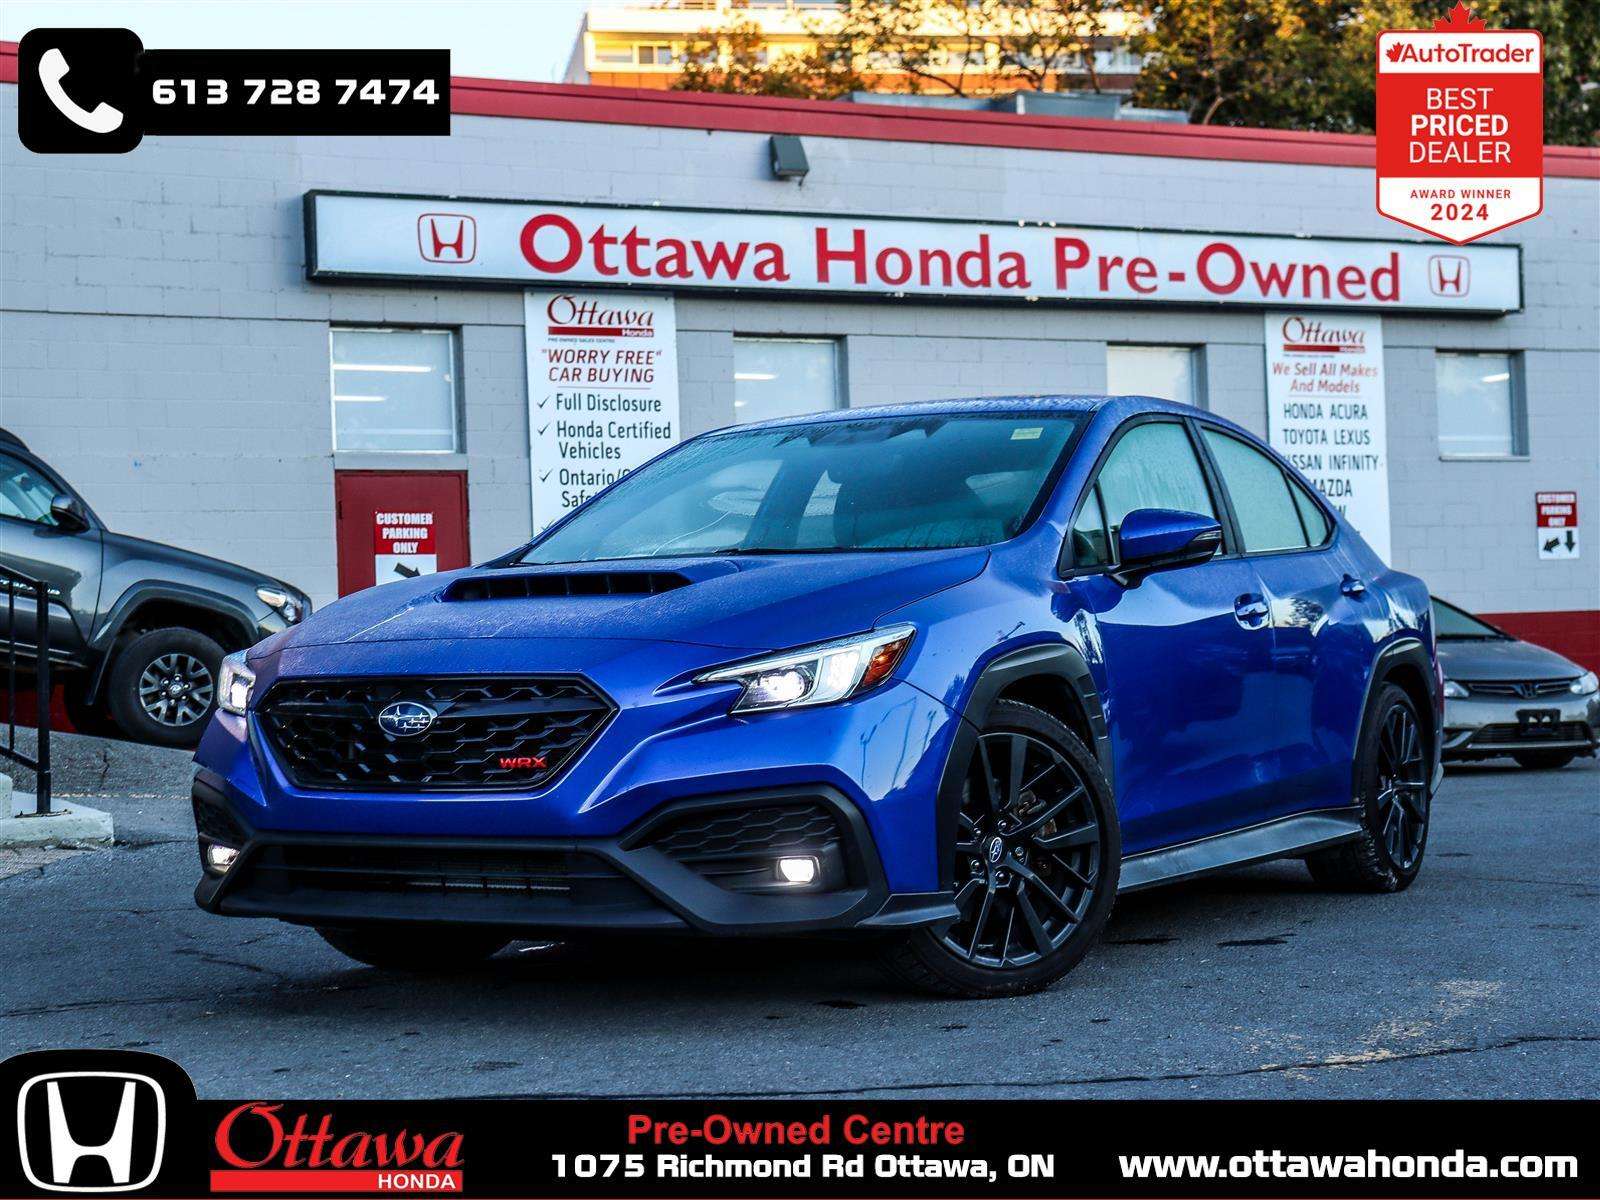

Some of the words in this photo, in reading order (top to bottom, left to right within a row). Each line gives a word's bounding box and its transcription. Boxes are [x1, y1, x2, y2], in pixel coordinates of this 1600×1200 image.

[519, 213, 790, 282] Ottawa
[815, 227, 1032, 288] Honda
[547, 294, 654, 326] Ottawa
[1282, 316, 1367, 343] Ottawa
[548, 367, 582, 382] CAR
[587, 368, 654, 383] BUYING
[1272, 362, 1291, 375] We
[1294, 362, 1317, 375] Sell
[1320, 363, 1336, 376] All
[1340, 364, 1378, 377] Makes
[1289, 379, 1314, 392] And
[1317, 380, 1361, 393] Models
[556, 393, 582, 411] Full
[587, 394, 662, 412] Disclosure
[1283, 403, 1324, 420] HONDA
[1330, 404, 1369, 420] ACURA
[557, 420, 604, 438] Honda
[608, 421, 672, 439] Certified
[1282, 429, 1329, 445] TOYOTA
[1334, 429, 1371, 445] LEXUS
[559, 442, 622, 459] Vehicles
[1283, 454, 1322, 470] SSAN
[1329, 455, 1379, 470] INFINITY
[376, 512, 434, 525] CUSTOMER
[382, 527, 429, 539] PARKING
[392, 541, 419, 554] ONLY
[500, 756, 547, 768] WRX
